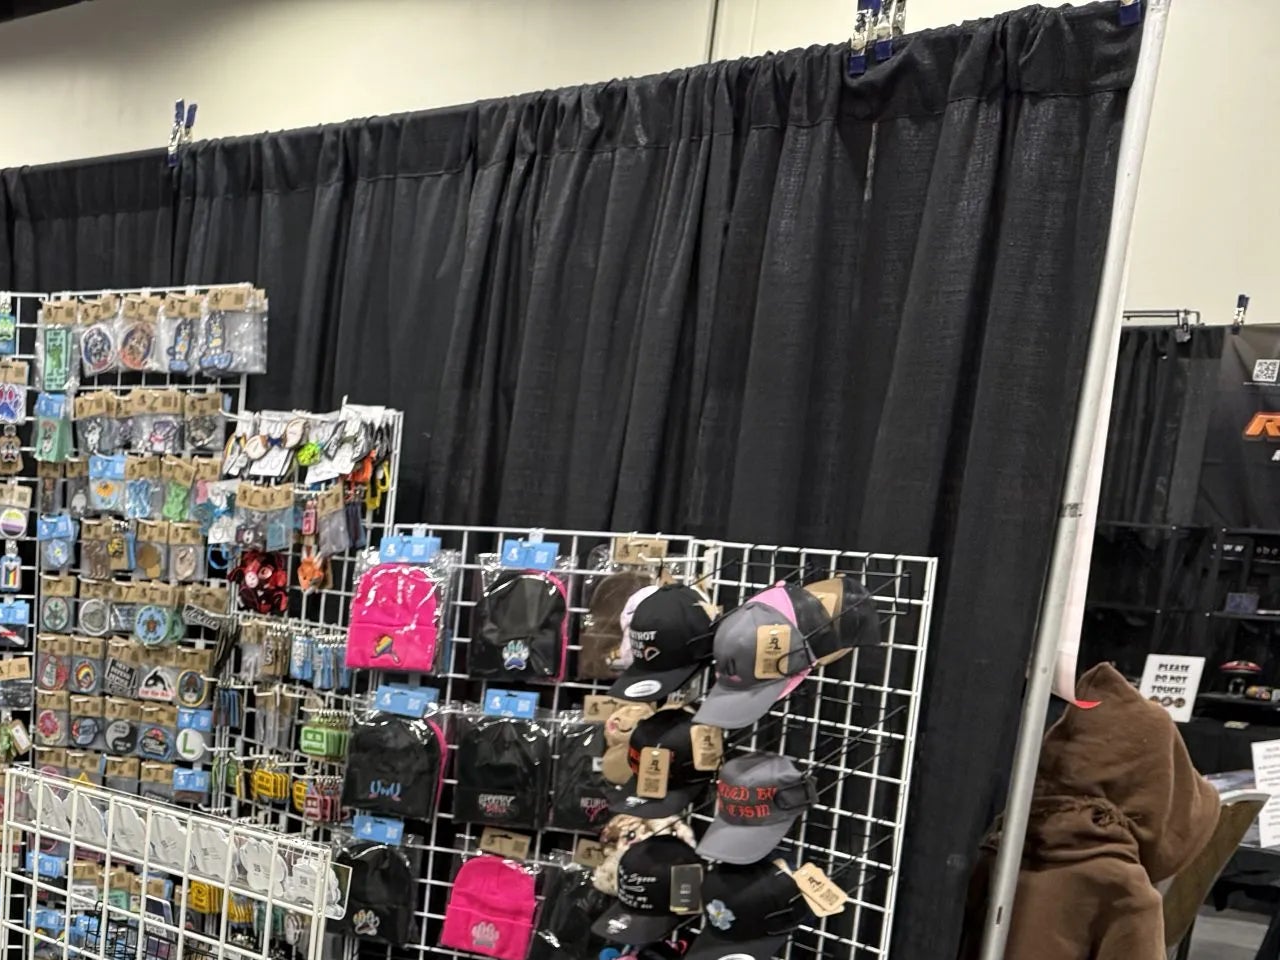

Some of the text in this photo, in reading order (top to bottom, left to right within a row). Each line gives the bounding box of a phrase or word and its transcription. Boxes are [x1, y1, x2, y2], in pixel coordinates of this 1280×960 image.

[1158, 663, 1190, 672] PLEASE
[1155, 674, 1188, 684] DO NOT
[1151, 685, 1186, 695] TOUCH!
